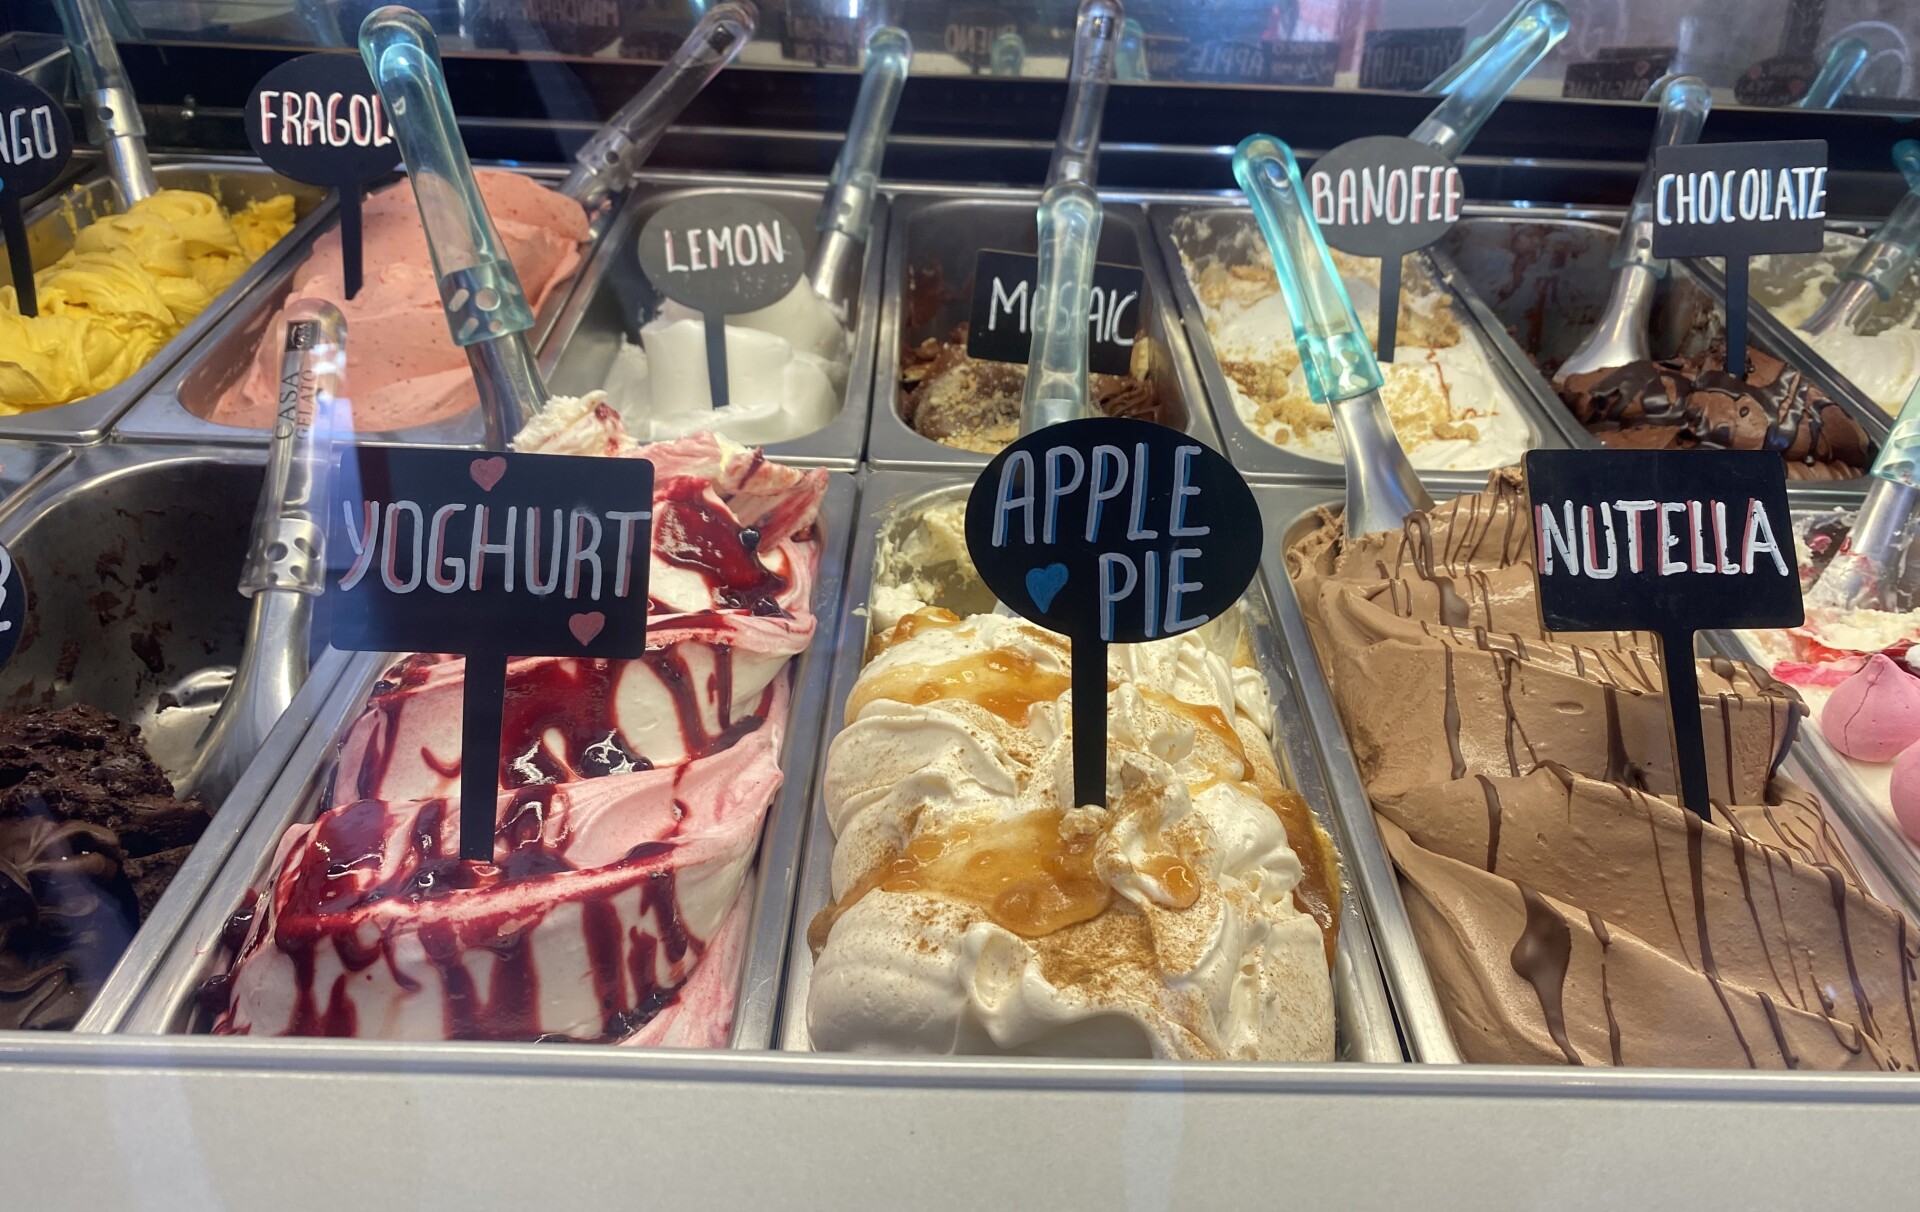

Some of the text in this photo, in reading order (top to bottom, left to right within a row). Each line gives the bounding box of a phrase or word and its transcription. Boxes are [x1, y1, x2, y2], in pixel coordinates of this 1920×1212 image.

[260, 90, 396, 148] FRAGOL
[1311, 164, 1461, 226] BANOFEE
[1656, 165, 1829, 226] CHOCOLATE
[663, 220, 785, 273] LEMON
[273, 371, 300, 441] CASA
[293, 369, 317, 441] GELATO
[991, 442, 1211, 548] APPLE
[337, 499, 651, 601] YOGHURT
[1534, 497, 1789, 580] NUTELLA
[1098, 548, 1210, 641] PIE
